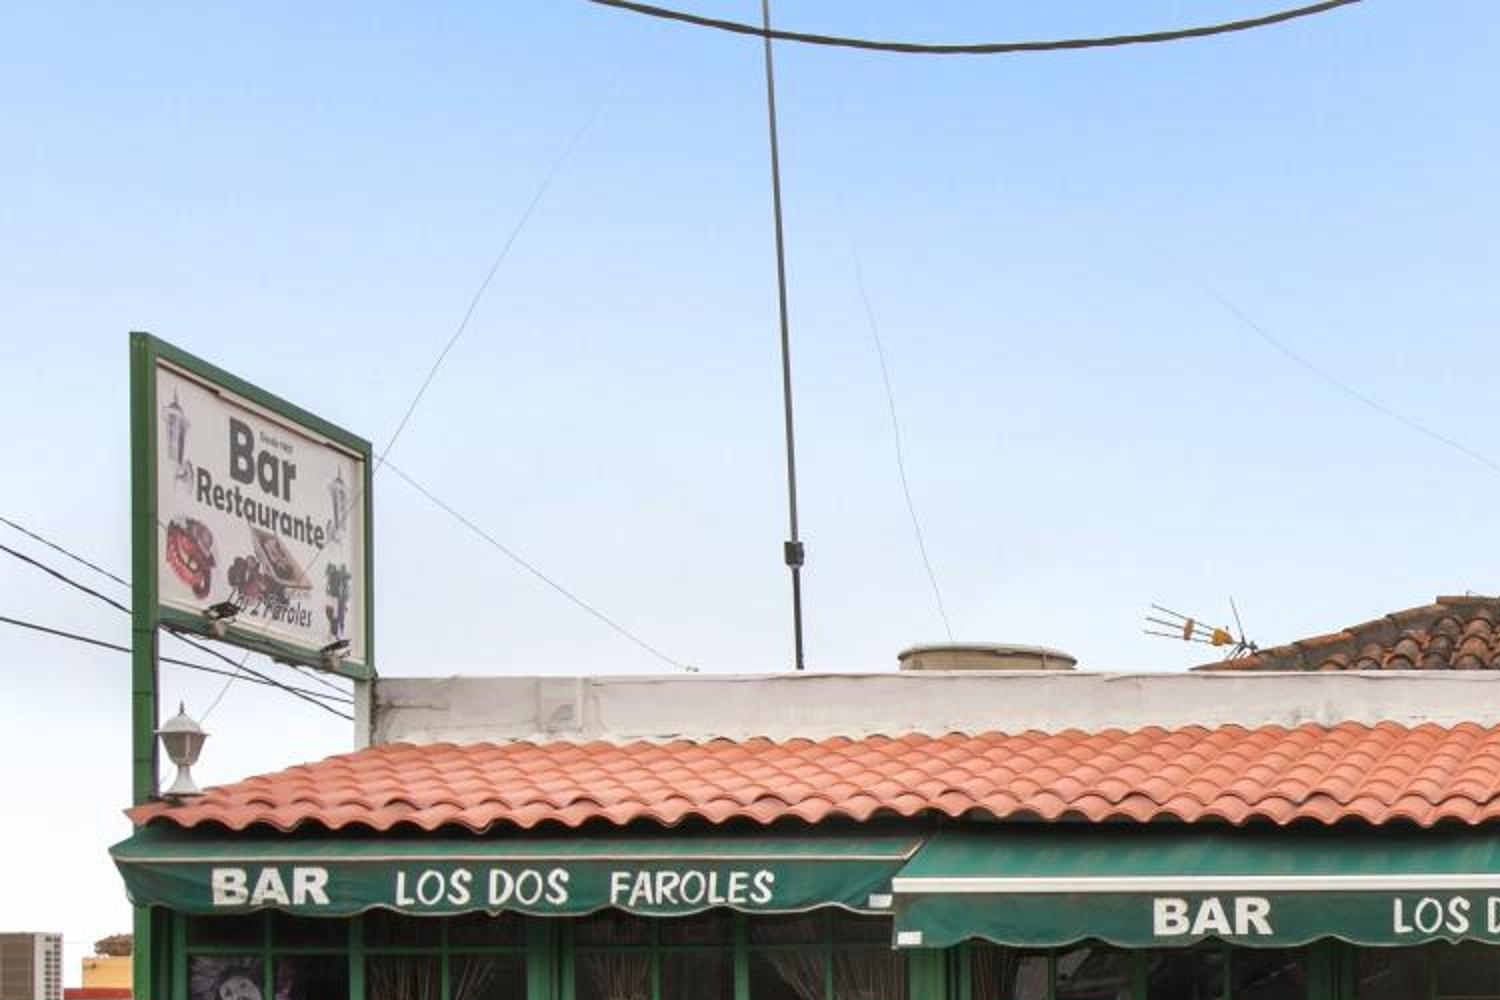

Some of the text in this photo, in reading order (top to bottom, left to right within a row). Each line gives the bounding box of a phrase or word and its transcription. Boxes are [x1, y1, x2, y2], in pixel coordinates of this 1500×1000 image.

[230, 416, 297, 503] Bar
[197, 466, 325, 550] Restaurante
[250, 594, 262, 617] 2
[263, 595, 312, 628] Faroles
[211, 866, 331, 906] BAR
[395, 867, 776, 906] LOS DOS FAROLES
[1152, 896, 1274, 936] BAR
[1393, 895, 1472, 934] LOS
